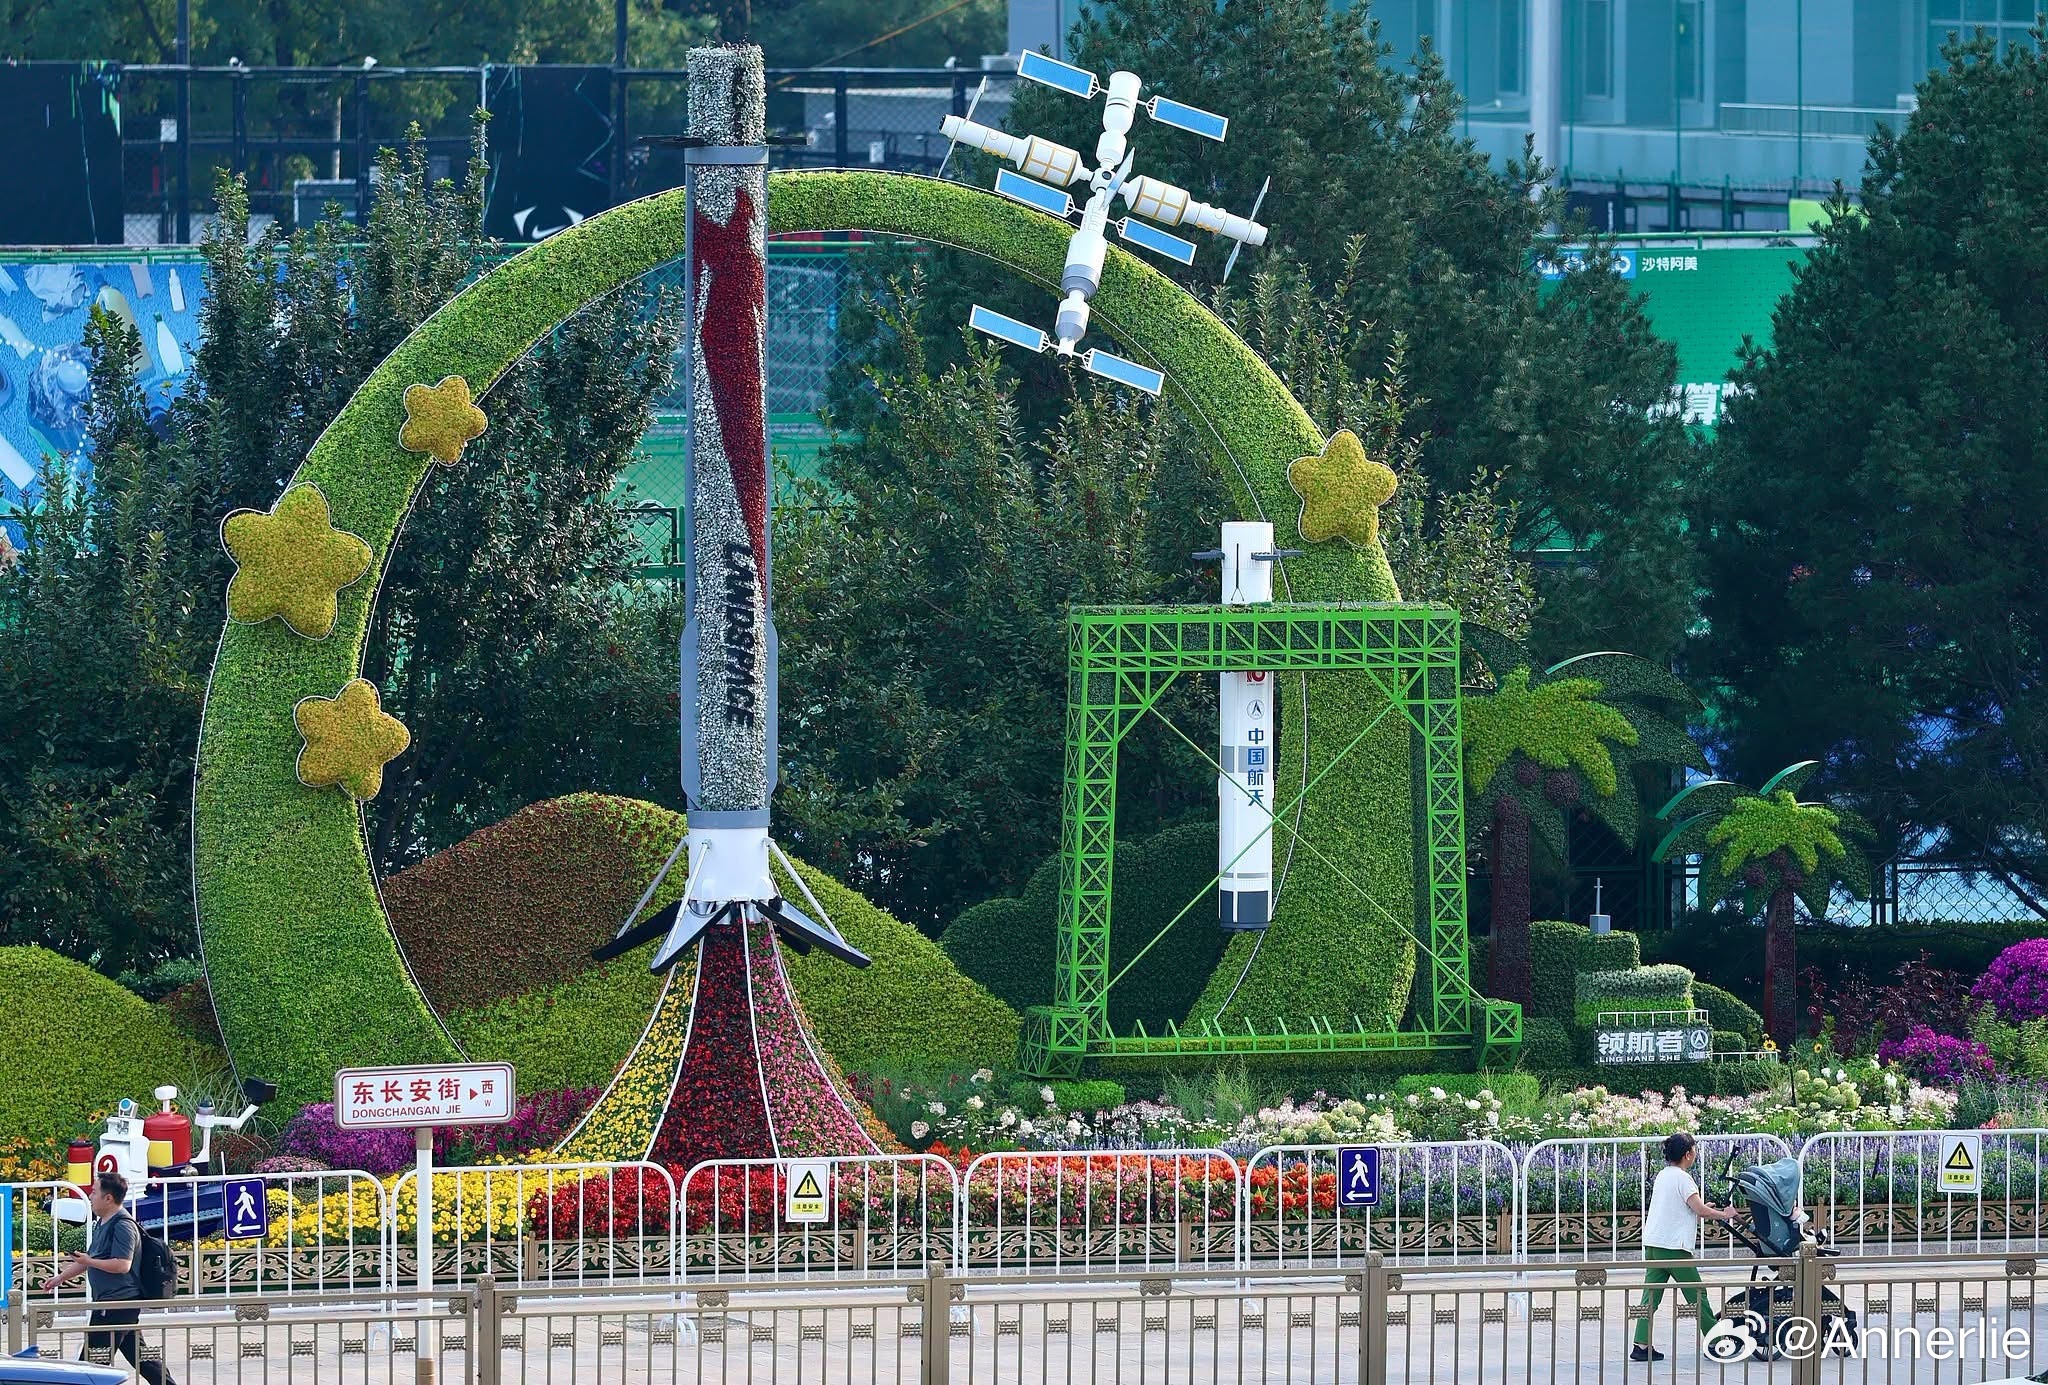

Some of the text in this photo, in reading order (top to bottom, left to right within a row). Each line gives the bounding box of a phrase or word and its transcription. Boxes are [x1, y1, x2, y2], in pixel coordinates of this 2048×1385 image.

[1642, 256, 1698, 272] 沙特阿美
[725, 541, 756, 729] LANDSPACE
[1247, 727, 1265, 807] 中国航天
[1597, 1029, 1684, 1056] 领航者
[1599, 1053, 1681, 1063] LING HANG ZHE
[352, 1077, 462, 1105] 东长安街
[480, 1079, 495, 1095] 西
[445, 1104, 462, 1115] JIE
[484, 1099, 492, 1108] W
